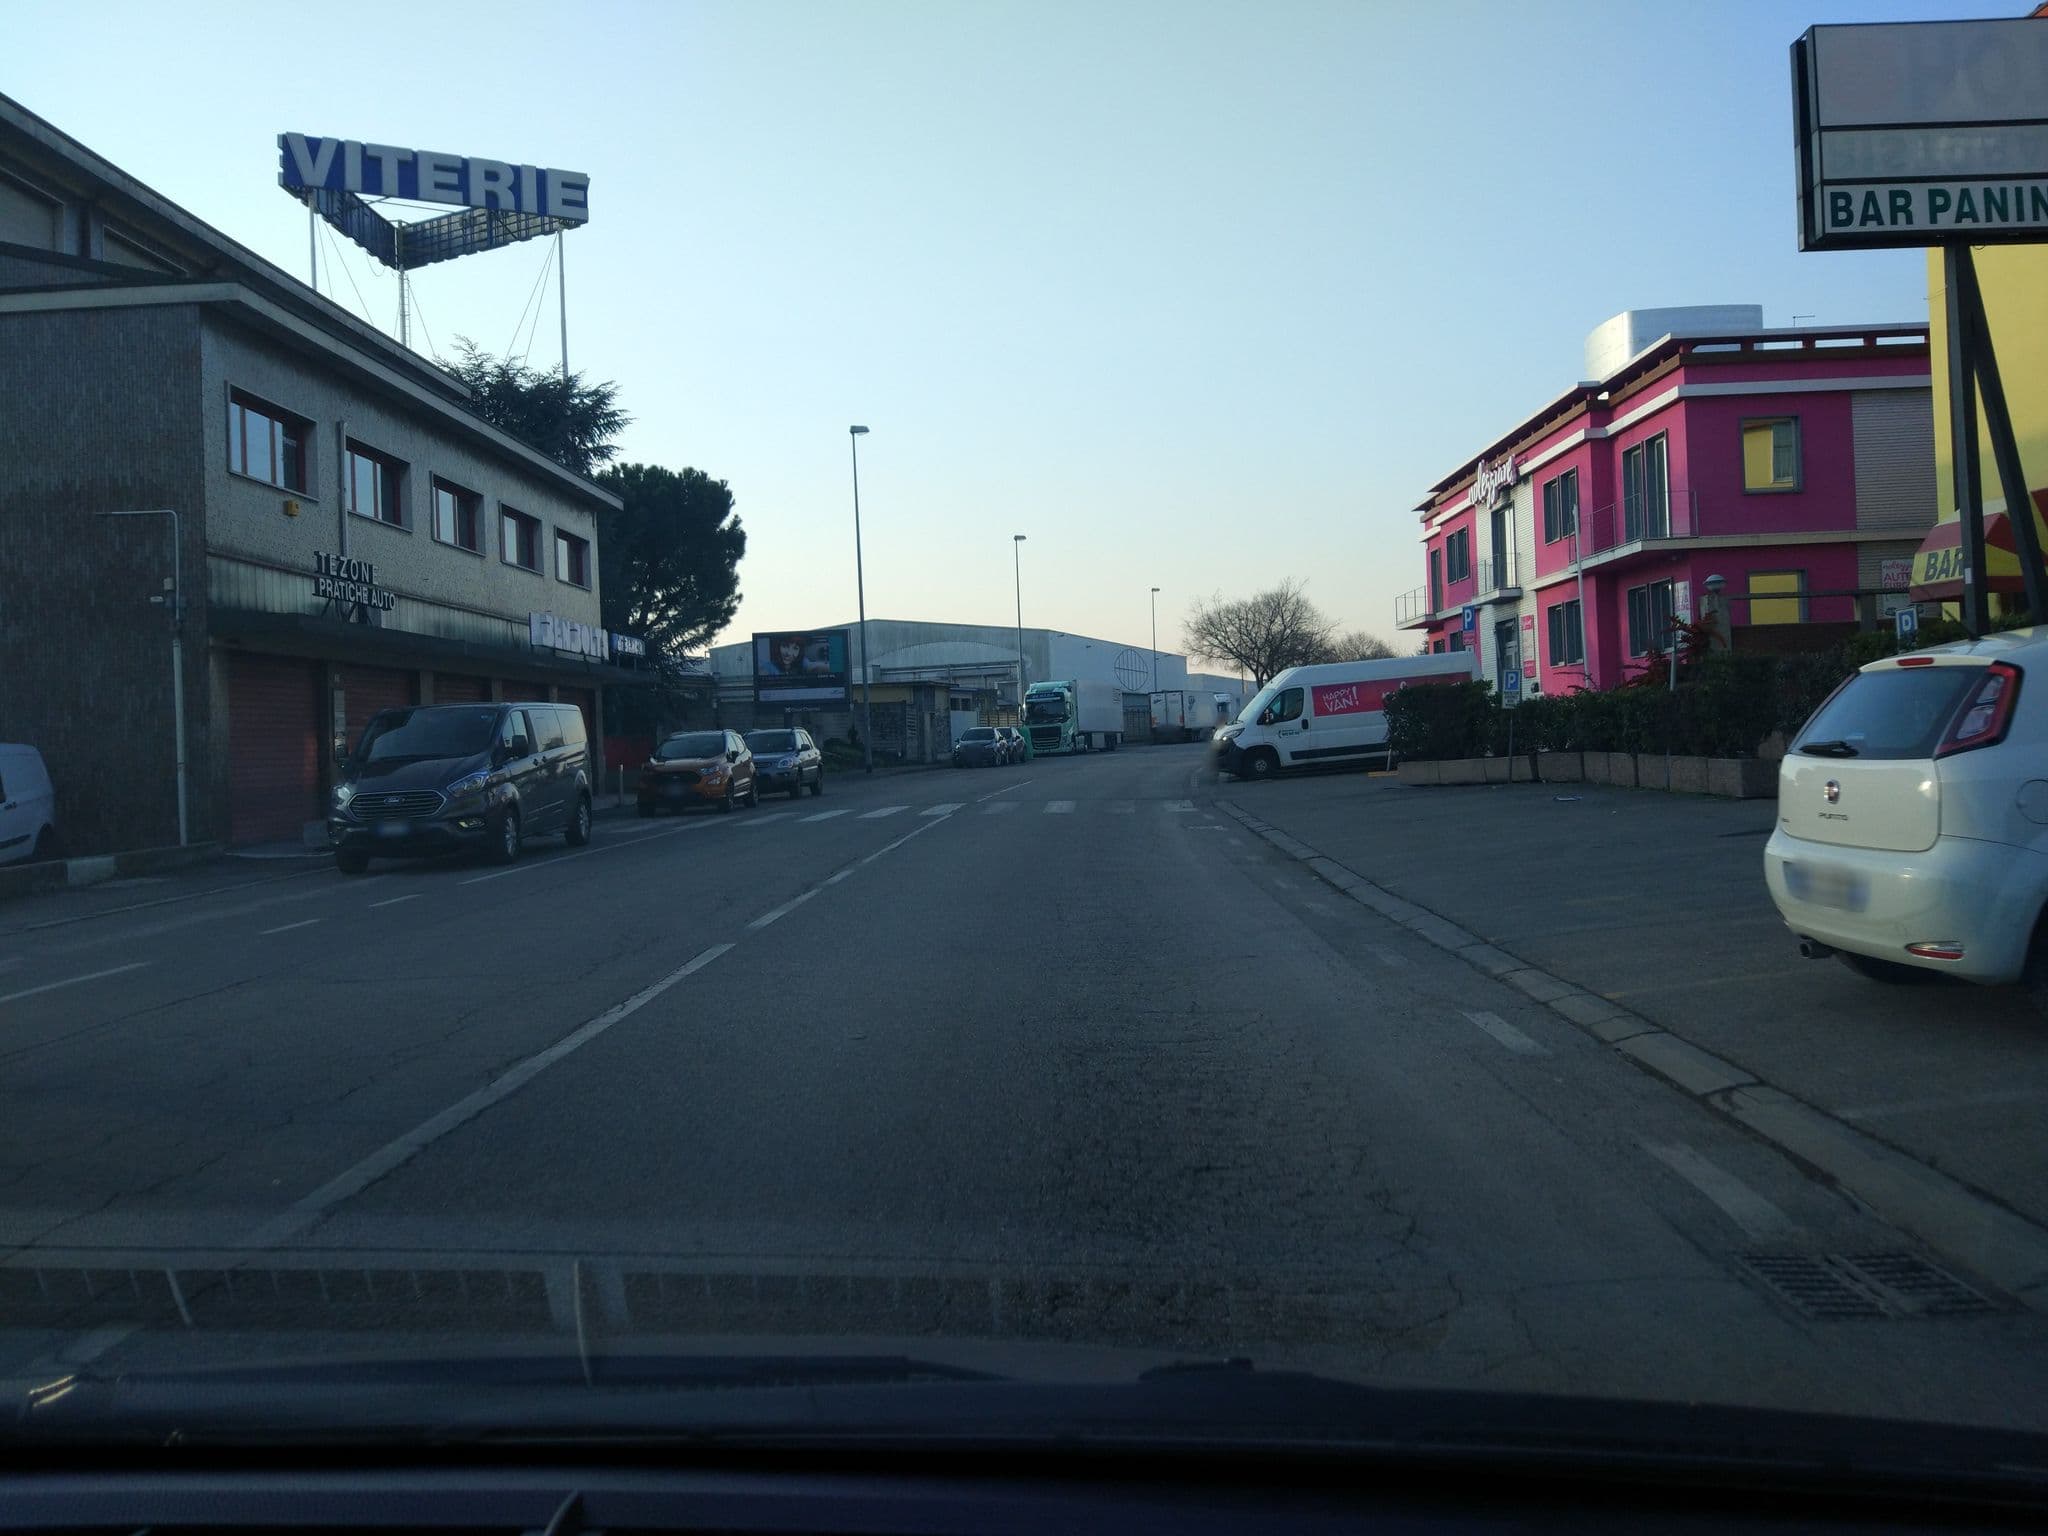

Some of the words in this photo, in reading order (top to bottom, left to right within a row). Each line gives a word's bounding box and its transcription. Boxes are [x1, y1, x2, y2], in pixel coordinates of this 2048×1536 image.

[284, 131, 589, 222] VITERIE
[1829, 189, 1914, 228] BAR
[1927, 185, 2048, 225] PANIN
[318, 551, 380, 585] TEZONE
[1924, 546, 1965, 582] BAR
[319, 578, 369, 605] PRATICHE
[371, 589, 397, 610] AUTO
[1464, 609, 1473, 629] P
[1323, 687, 1351, 700] HAPPY
[1507, 673, 1517, 688] P
